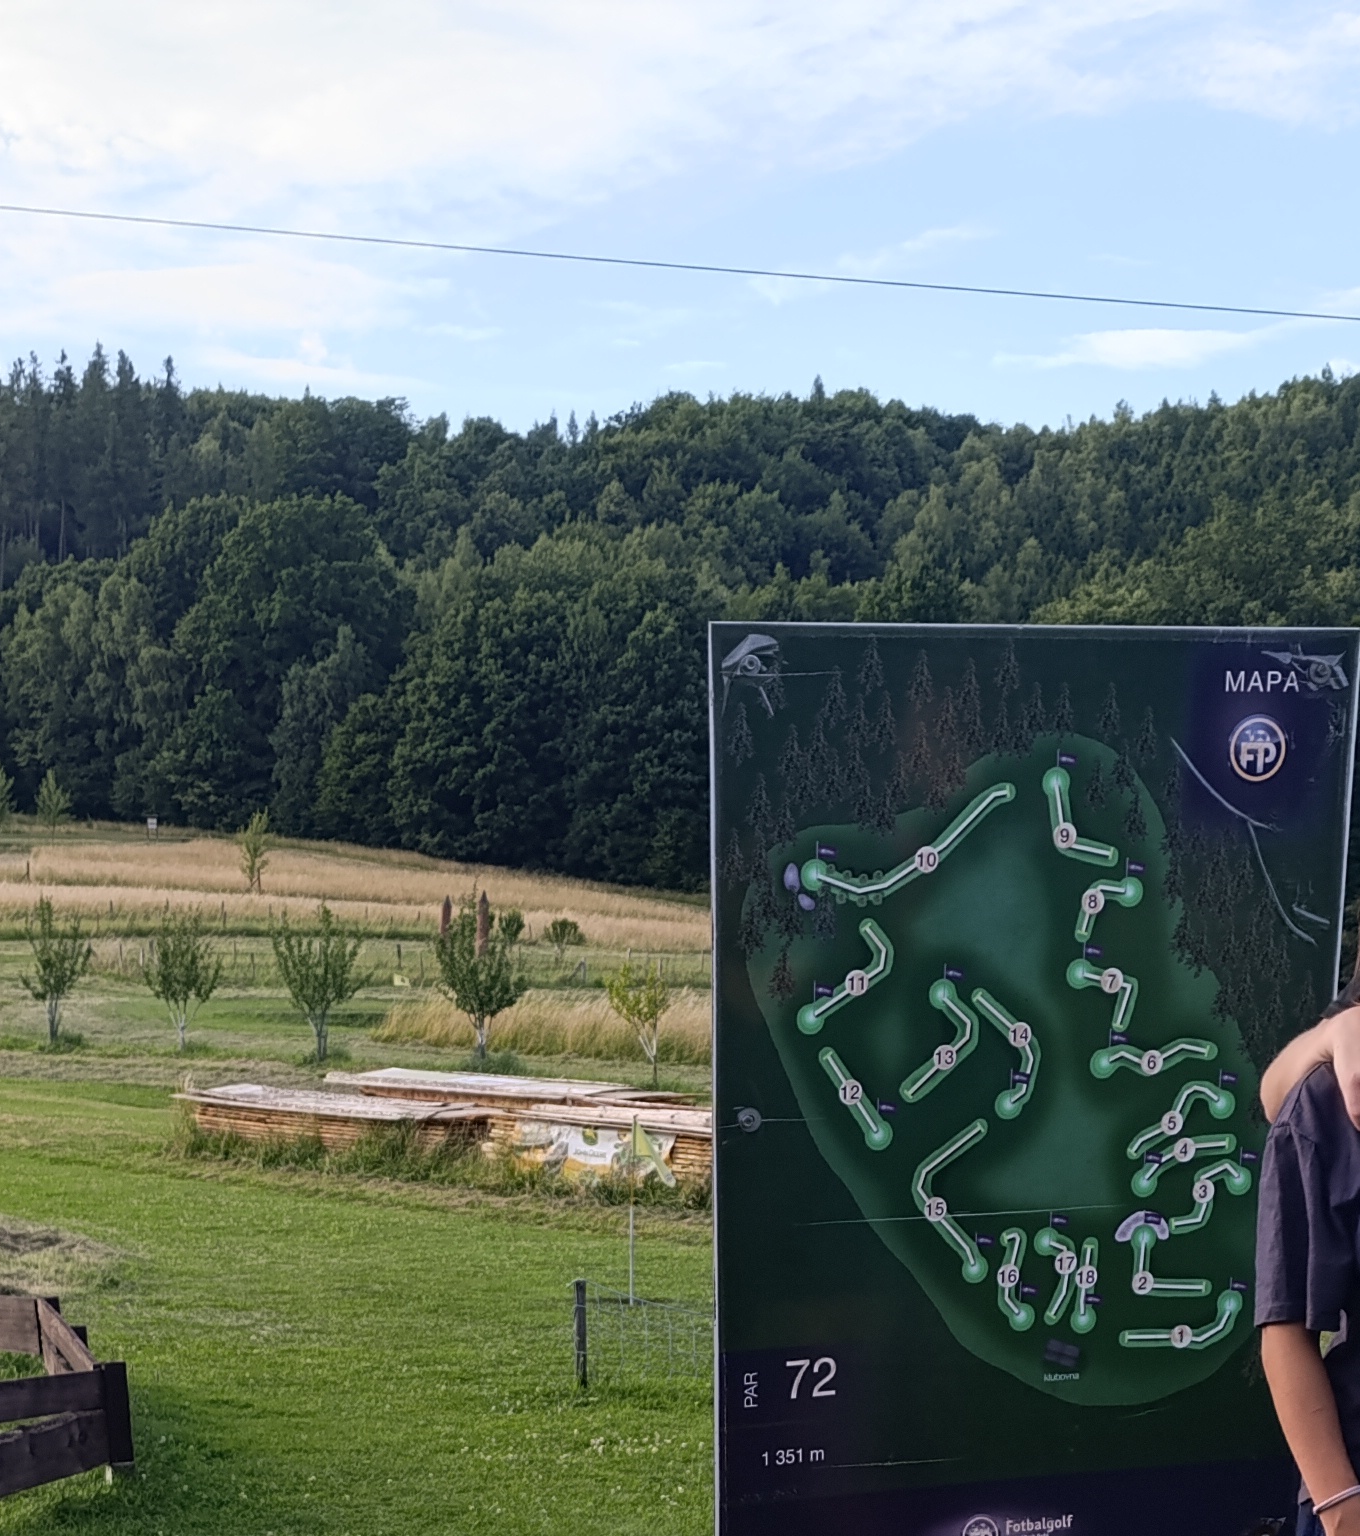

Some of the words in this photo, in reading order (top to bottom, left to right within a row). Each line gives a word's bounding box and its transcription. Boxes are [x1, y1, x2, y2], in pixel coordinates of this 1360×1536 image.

[1224, 670, 1300, 693] MAPA
[1059, 828, 1070, 843] 9
[916, 852, 937, 869] 10
[1087, 894, 1098, 909] 8
[848, 975, 866, 991] 11
[1107, 974, 1117, 989] 7
[1011, 1027, 1029, 1043] 14
[935, 1050, 954, 1065] 13
[1147, 1054, 1157, 1070] 6
[840, 1084, 860, 1100] 12
[1167, 1115, 1177, 1131] 5
[1179, 1142, 1188, 1158] 4
[1198, 1184, 1208, 1199] 3
[925, 1202, 945, 1217] 15
[1057, 1256, 1075, 1271] 17
[998, 1269, 1018, 1284] 16
[1077, 1270, 1096, 1285] 18
[1137, 1276, 1148, 1290] 2
[785, 1356, 837, 1400] 72
[743, 1371, 759, 1409] PAR
[761, 1450, 769, 1467] 1
[775, 1447, 803, 1466] 351
[809, 1448, 825, 1462] m
[1005, 1514, 1074, 1536] Fotbalgolf
